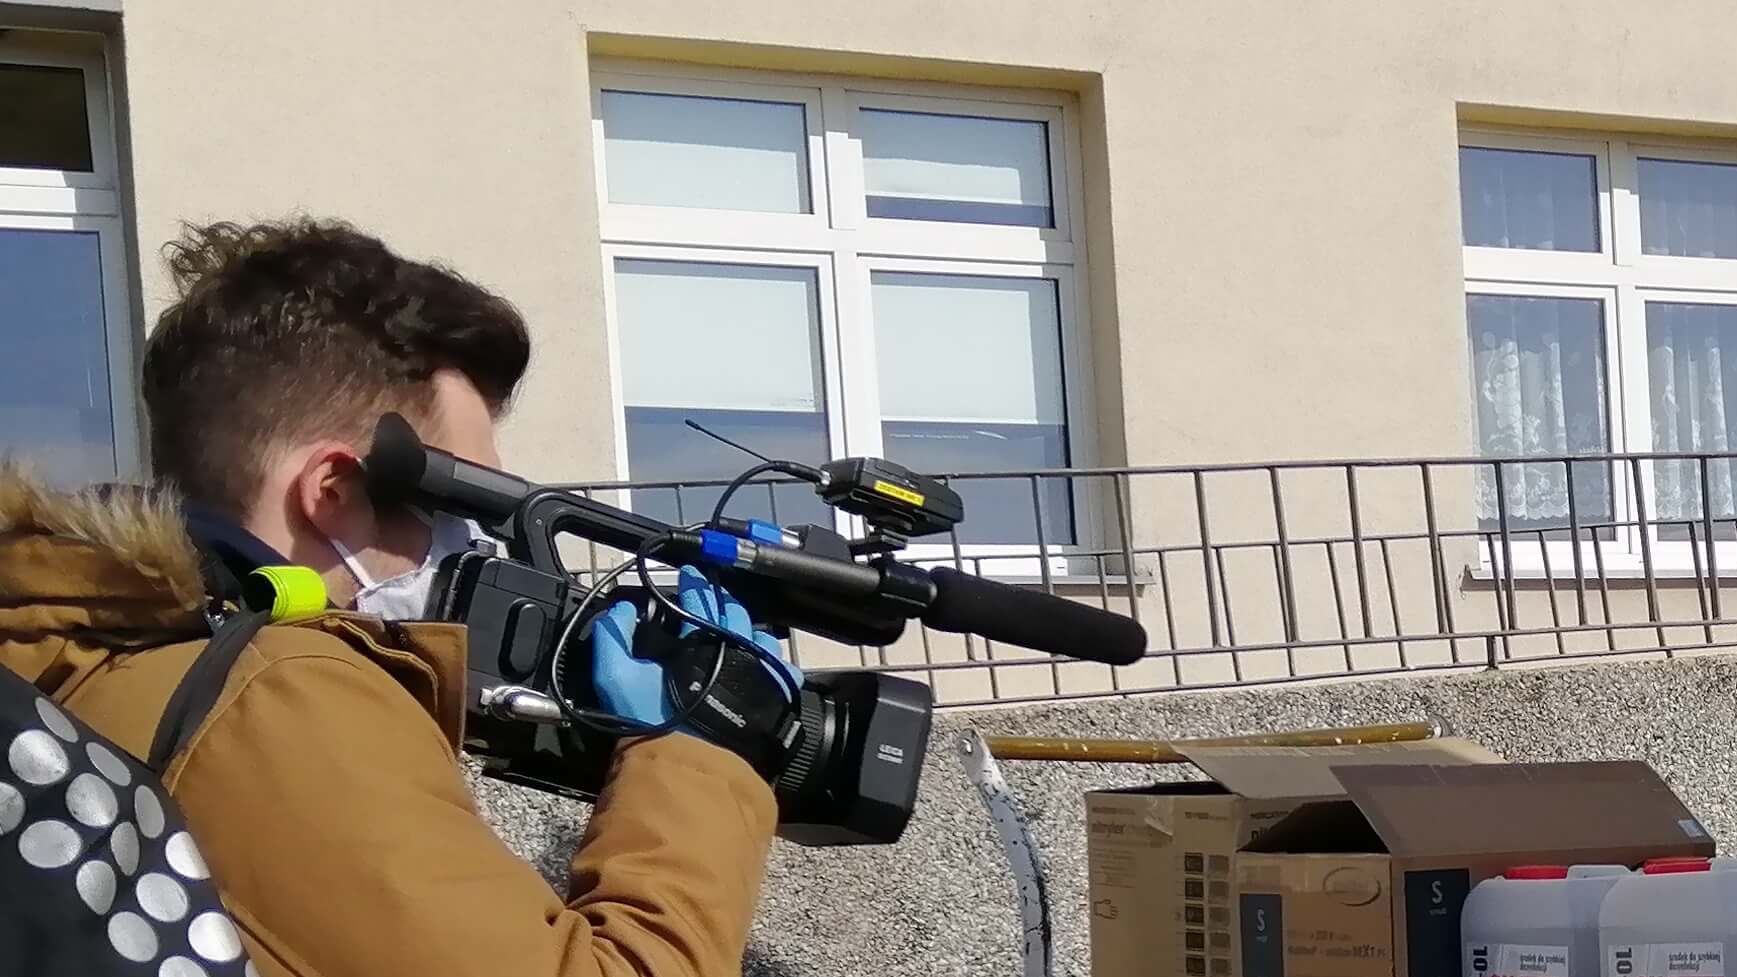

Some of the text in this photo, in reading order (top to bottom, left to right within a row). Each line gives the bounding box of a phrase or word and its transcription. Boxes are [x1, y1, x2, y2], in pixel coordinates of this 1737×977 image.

[688, 681, 747, 728] Pnasonic
[1432, 881, 1443, 904] S
[1257, 908, 1266, 931] S
